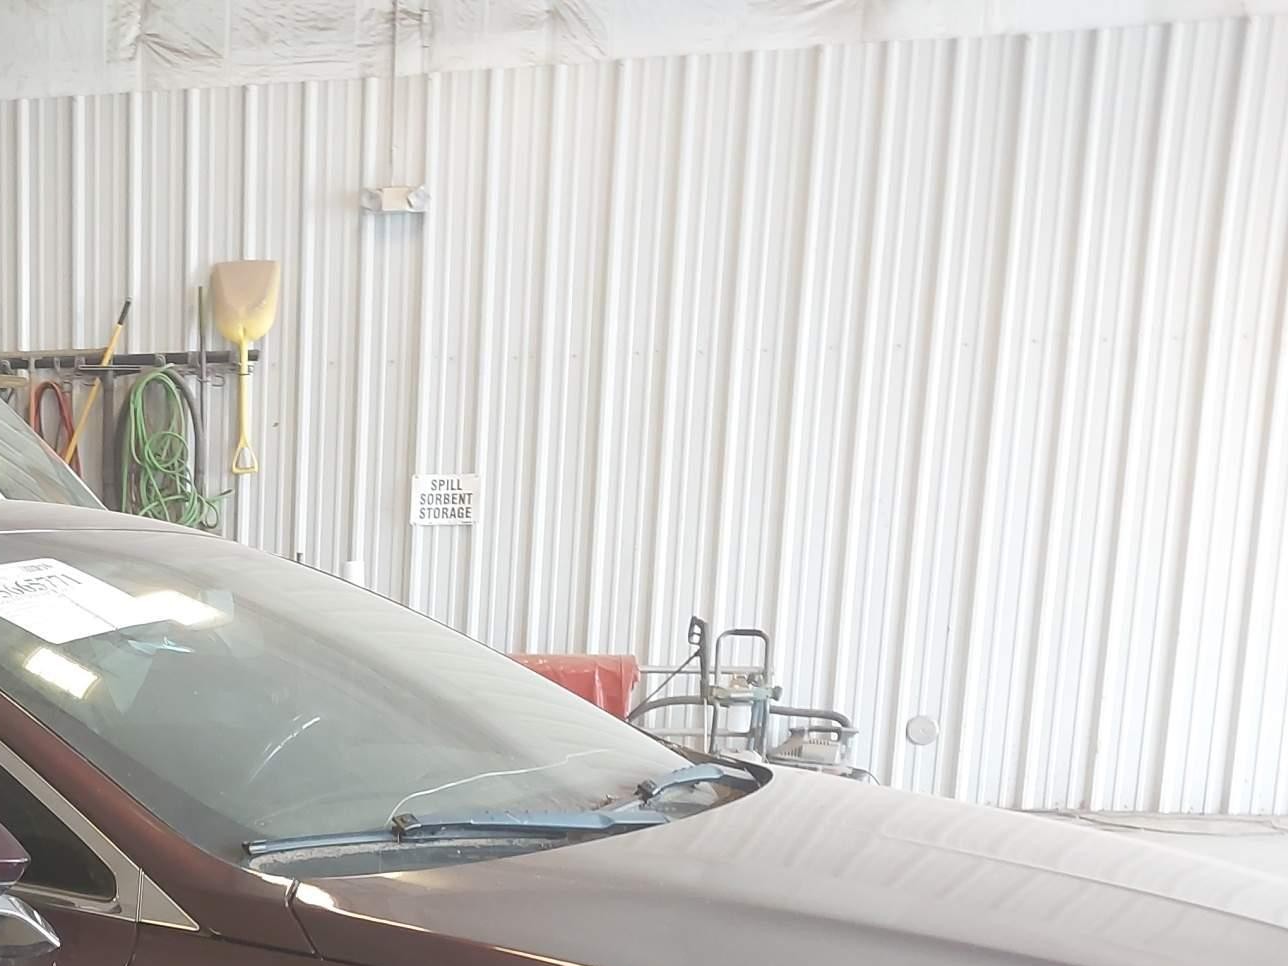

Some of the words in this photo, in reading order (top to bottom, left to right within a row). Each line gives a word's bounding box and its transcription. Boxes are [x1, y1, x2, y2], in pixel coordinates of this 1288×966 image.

[430, 478, 463, 491] SPILL
[419, 492, 473, 506] SORBENT
[418, 506, 473, 520] STORAGE
